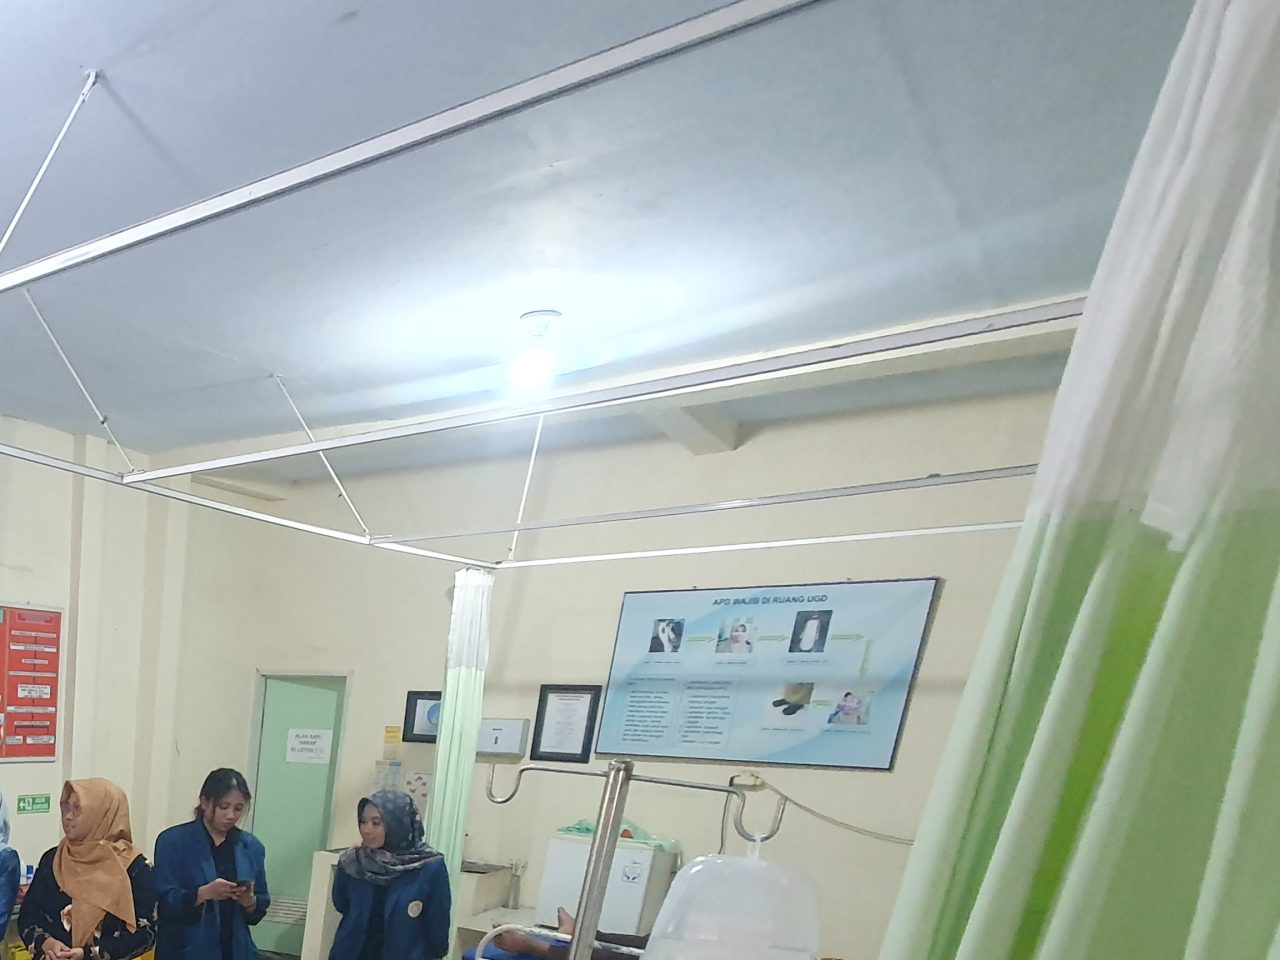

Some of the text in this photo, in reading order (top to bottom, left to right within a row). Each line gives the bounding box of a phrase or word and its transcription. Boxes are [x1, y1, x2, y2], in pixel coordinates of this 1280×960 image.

[761, 596, 771, 604] DI
[771, 595, 805, 604] RUANG
[806, 594, 828, 603] UGD
